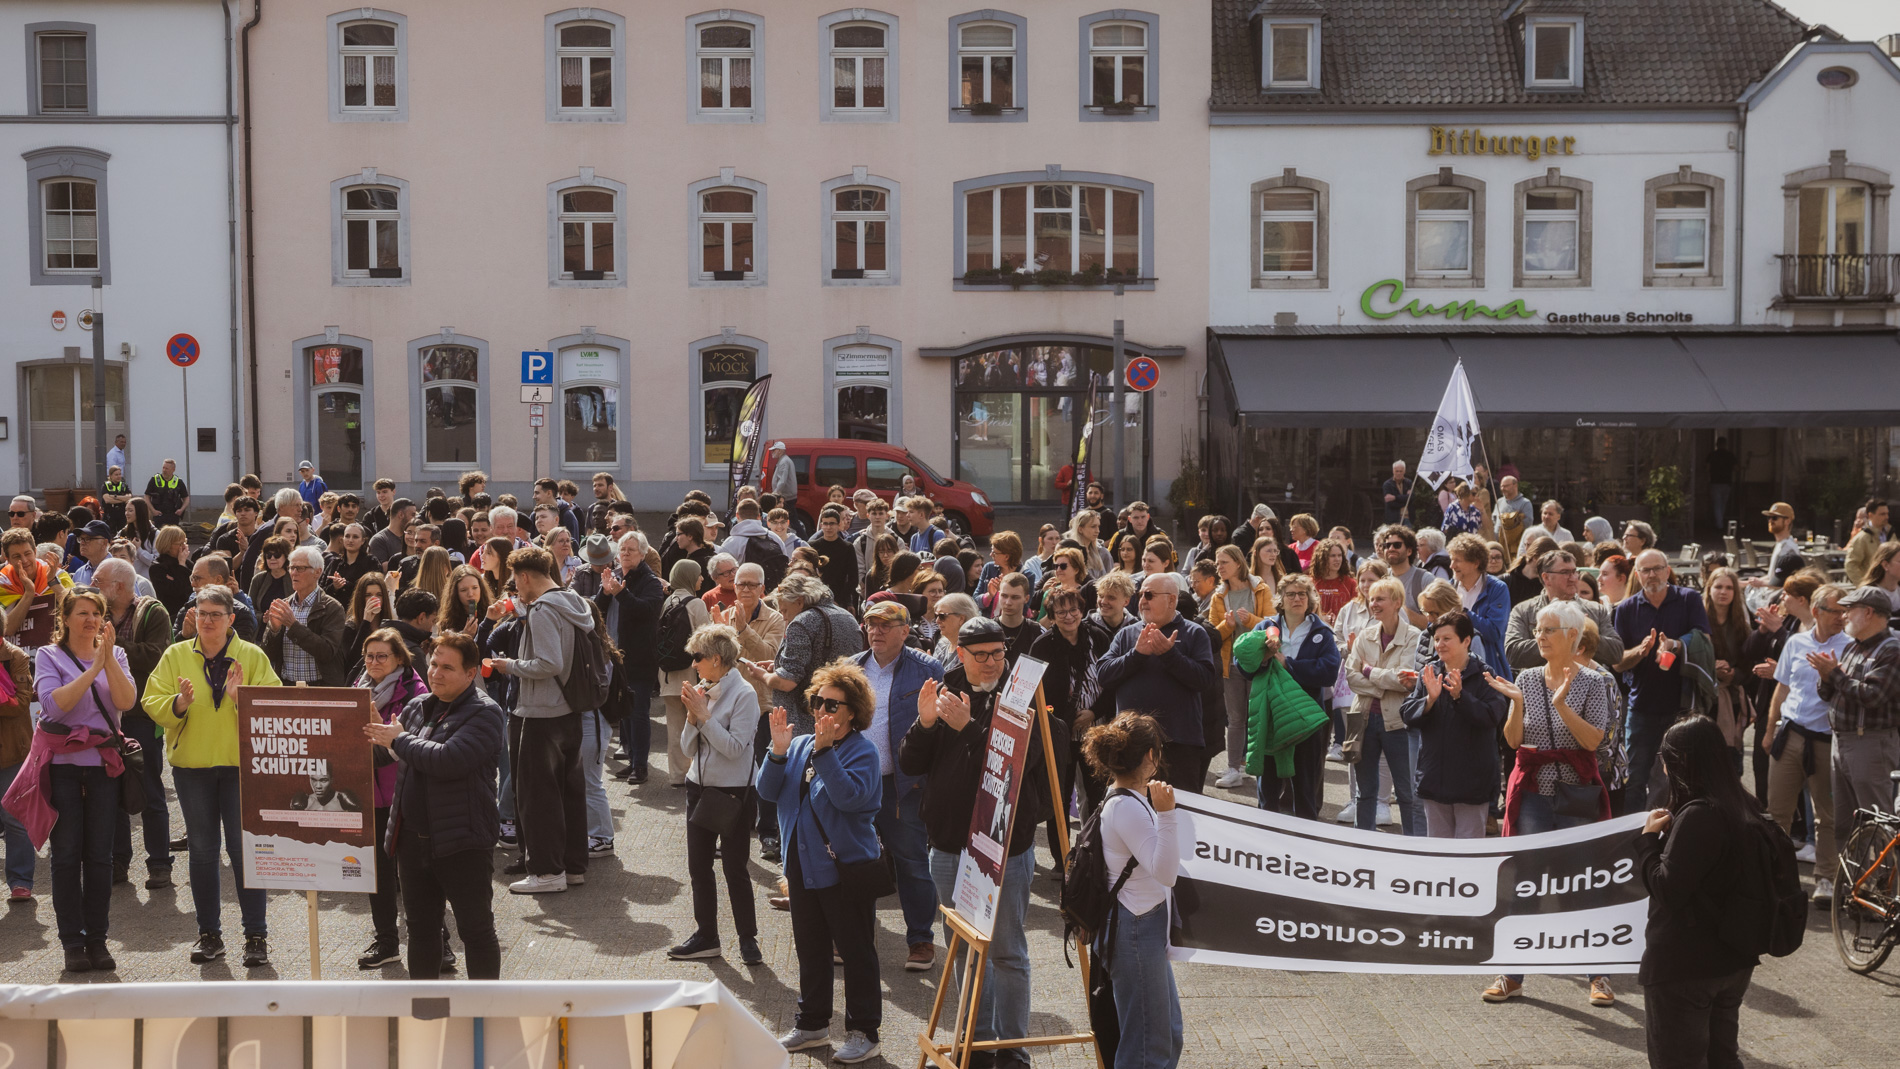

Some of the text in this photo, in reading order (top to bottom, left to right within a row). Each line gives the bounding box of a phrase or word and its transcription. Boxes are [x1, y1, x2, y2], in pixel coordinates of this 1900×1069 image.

[1428, 126, 1576, 160] Bitburger
[1361, 279, 1537, 320] Cuma
[1547, 312, 1621, 323] Gasthaus
[528, 355, 547, 380] P
[708, 362, 750, 373] MOCK
[846, 353, 887, 361] Zimmermann
[1437, 425, 1445, 452] OMAS
[250, 717, 332, 735] MENSCHEN
[251, 734, 308, 755] WÜRDE
[989, 727, 1016, 757] MENSCHEN
[251, 754, 328, 776] SCHÜTZEN
